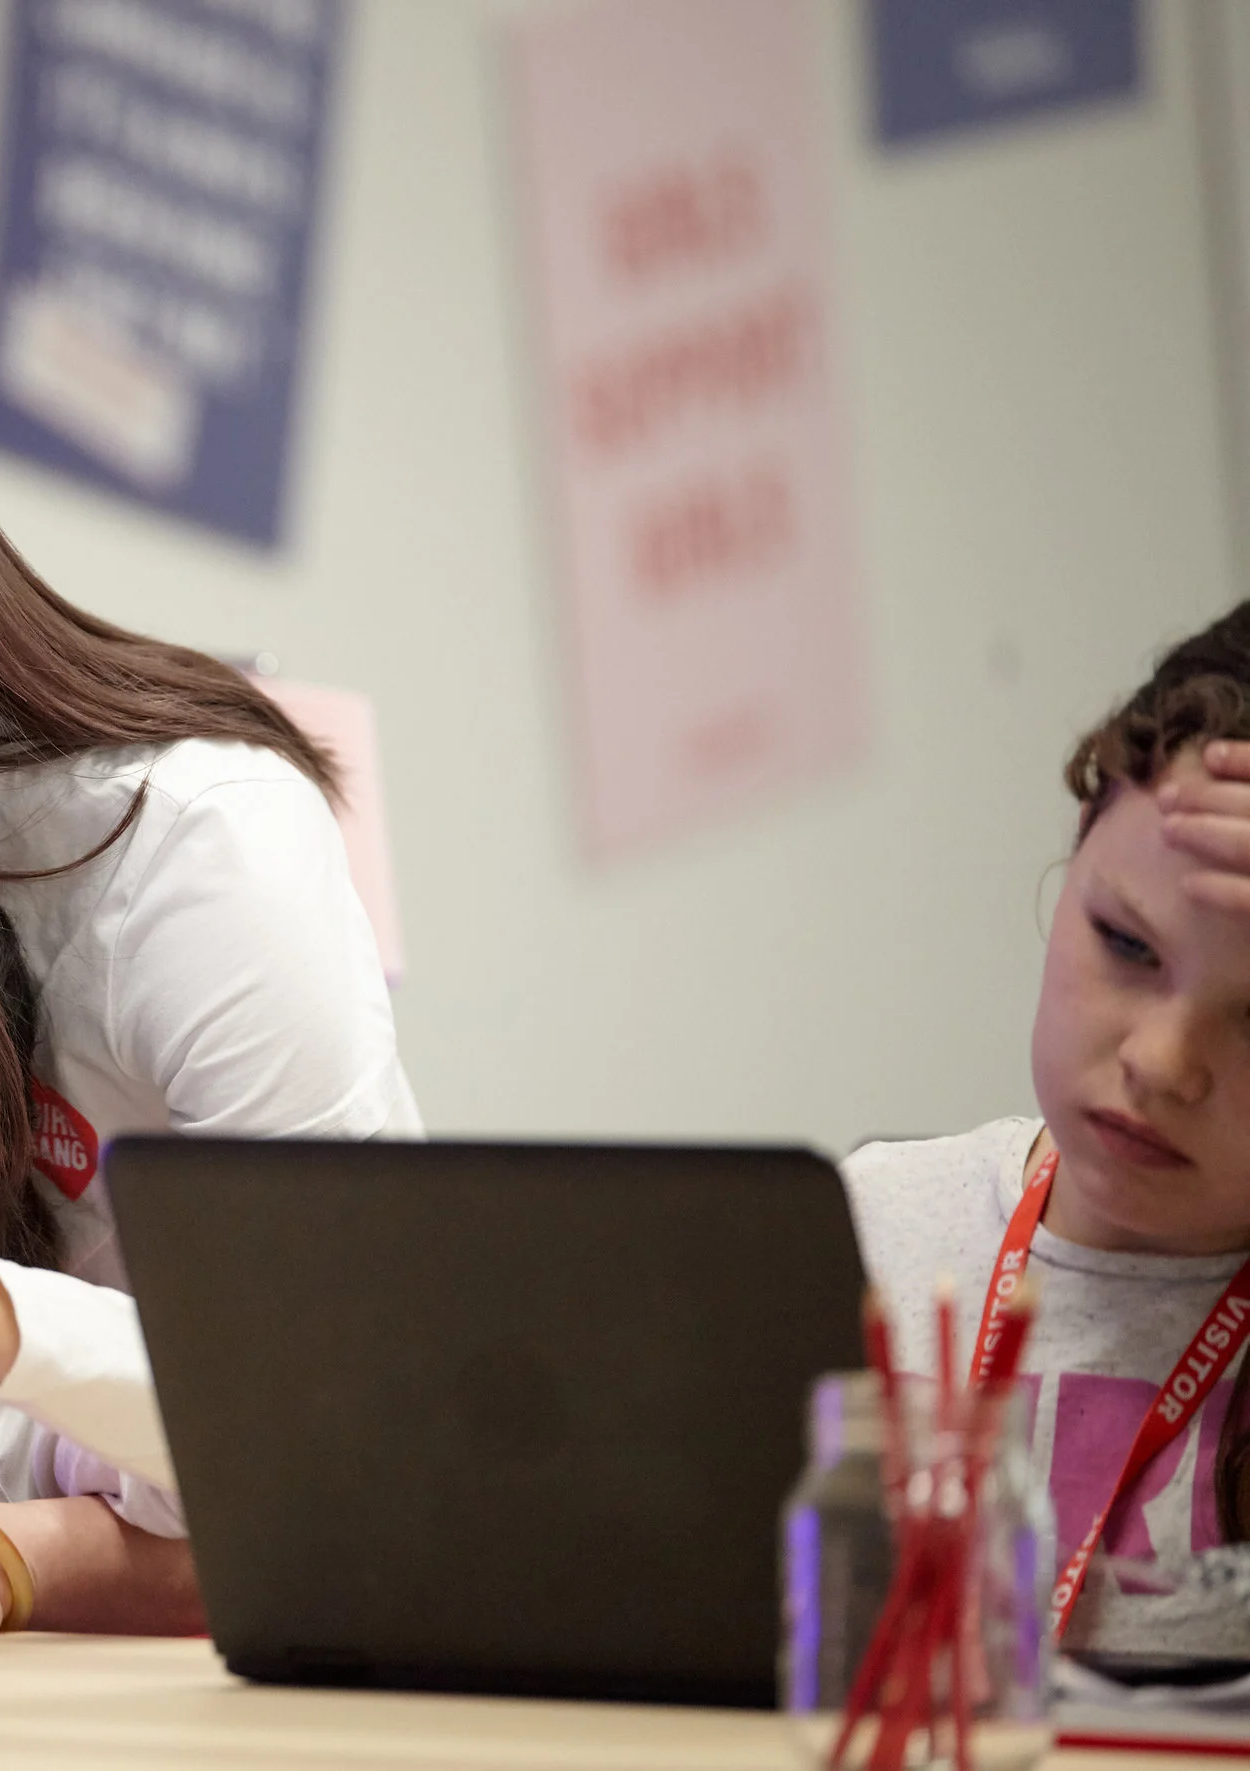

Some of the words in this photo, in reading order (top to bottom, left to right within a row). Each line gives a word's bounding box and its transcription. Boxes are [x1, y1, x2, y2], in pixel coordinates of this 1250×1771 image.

[32, 1102, 79, 1138] IRL
[34, 1135, 88, 1171] ANG
[977, 1249, 1024, 1388] ISITOR
[1158, 1295, 1250, 1423] VISITOR
